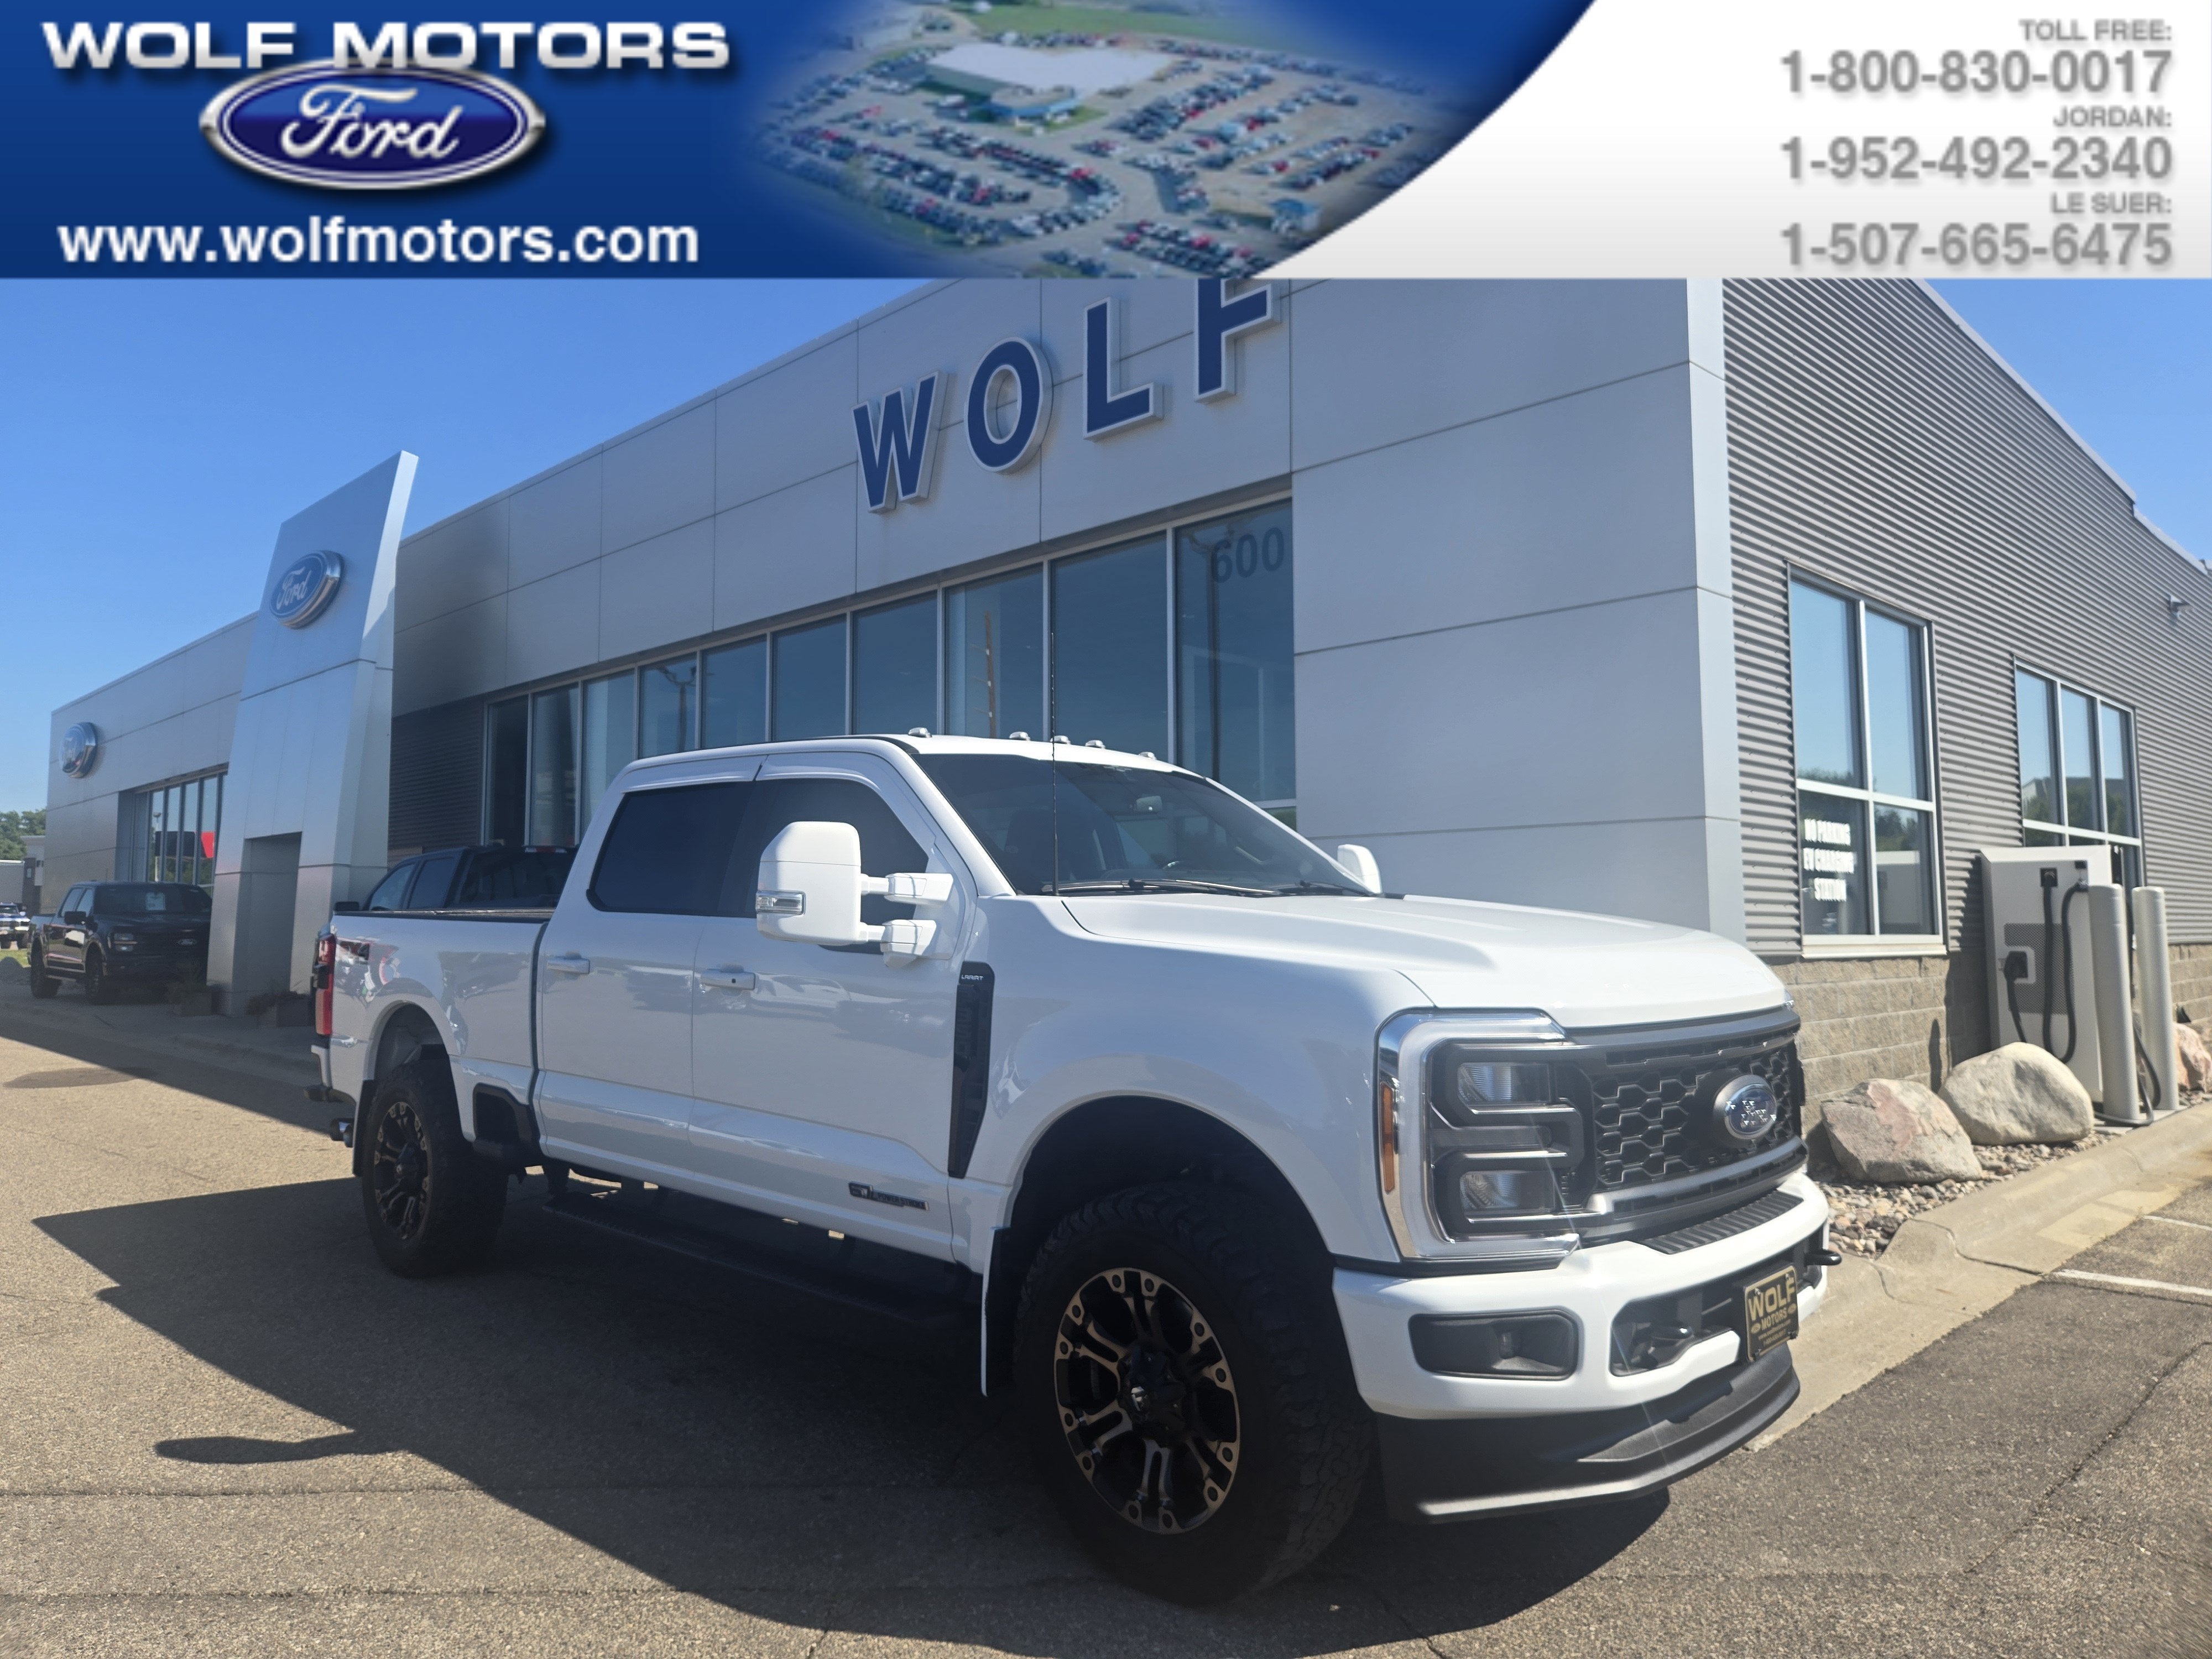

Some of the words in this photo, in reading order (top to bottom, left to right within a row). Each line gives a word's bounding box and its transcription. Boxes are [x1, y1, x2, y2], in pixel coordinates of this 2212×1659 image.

[851, 278, 1282, 513] WOLF
[1212, 527, 1284, 583] 600
[276, 566, 312, 610] Ford
[1748, 1277, 1796, 1321] WOLF
[1761, 1307, 1788, 1331] MOTORS
